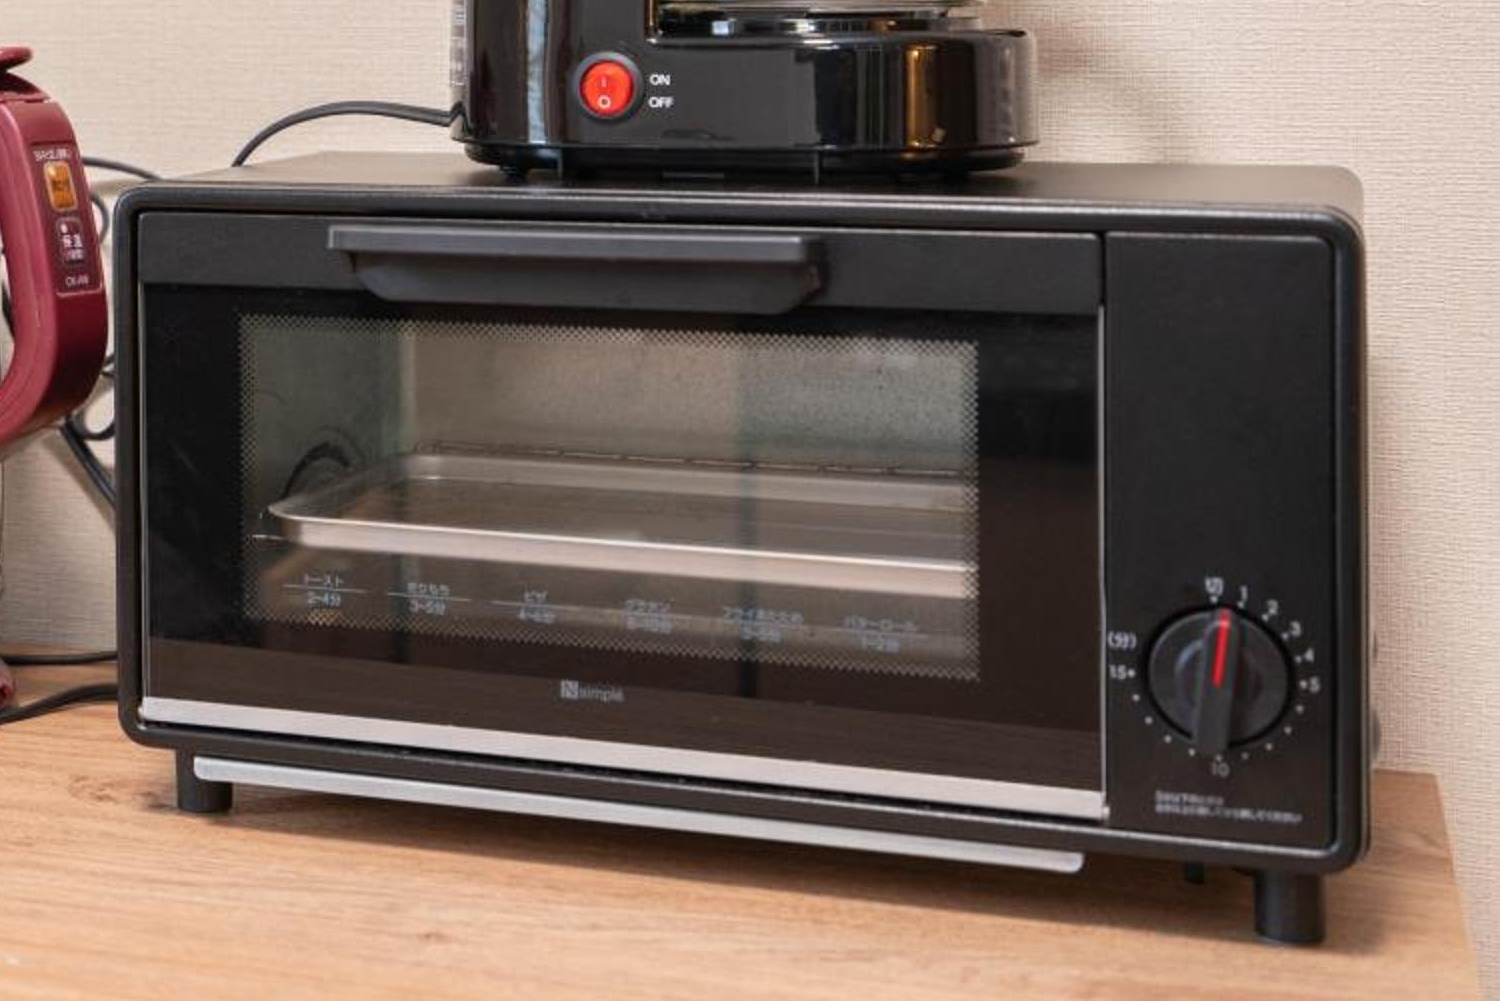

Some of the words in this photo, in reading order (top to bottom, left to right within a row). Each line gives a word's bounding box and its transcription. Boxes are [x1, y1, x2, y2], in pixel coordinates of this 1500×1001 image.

[650, 74, 671, 86] ON
[648, 96, 673, 108] OFF
[1240, 586, 1248, 601] 1
[1268, 600, 1279, 615] 2
[1290, 621, 1301, 636] 3
[1304, 649, 1315, 662] 4
[1108, 664, 1126, 679] 15
[1309, 678, 1321, 692] 5
[1211, 764, 1230, 777] 10
